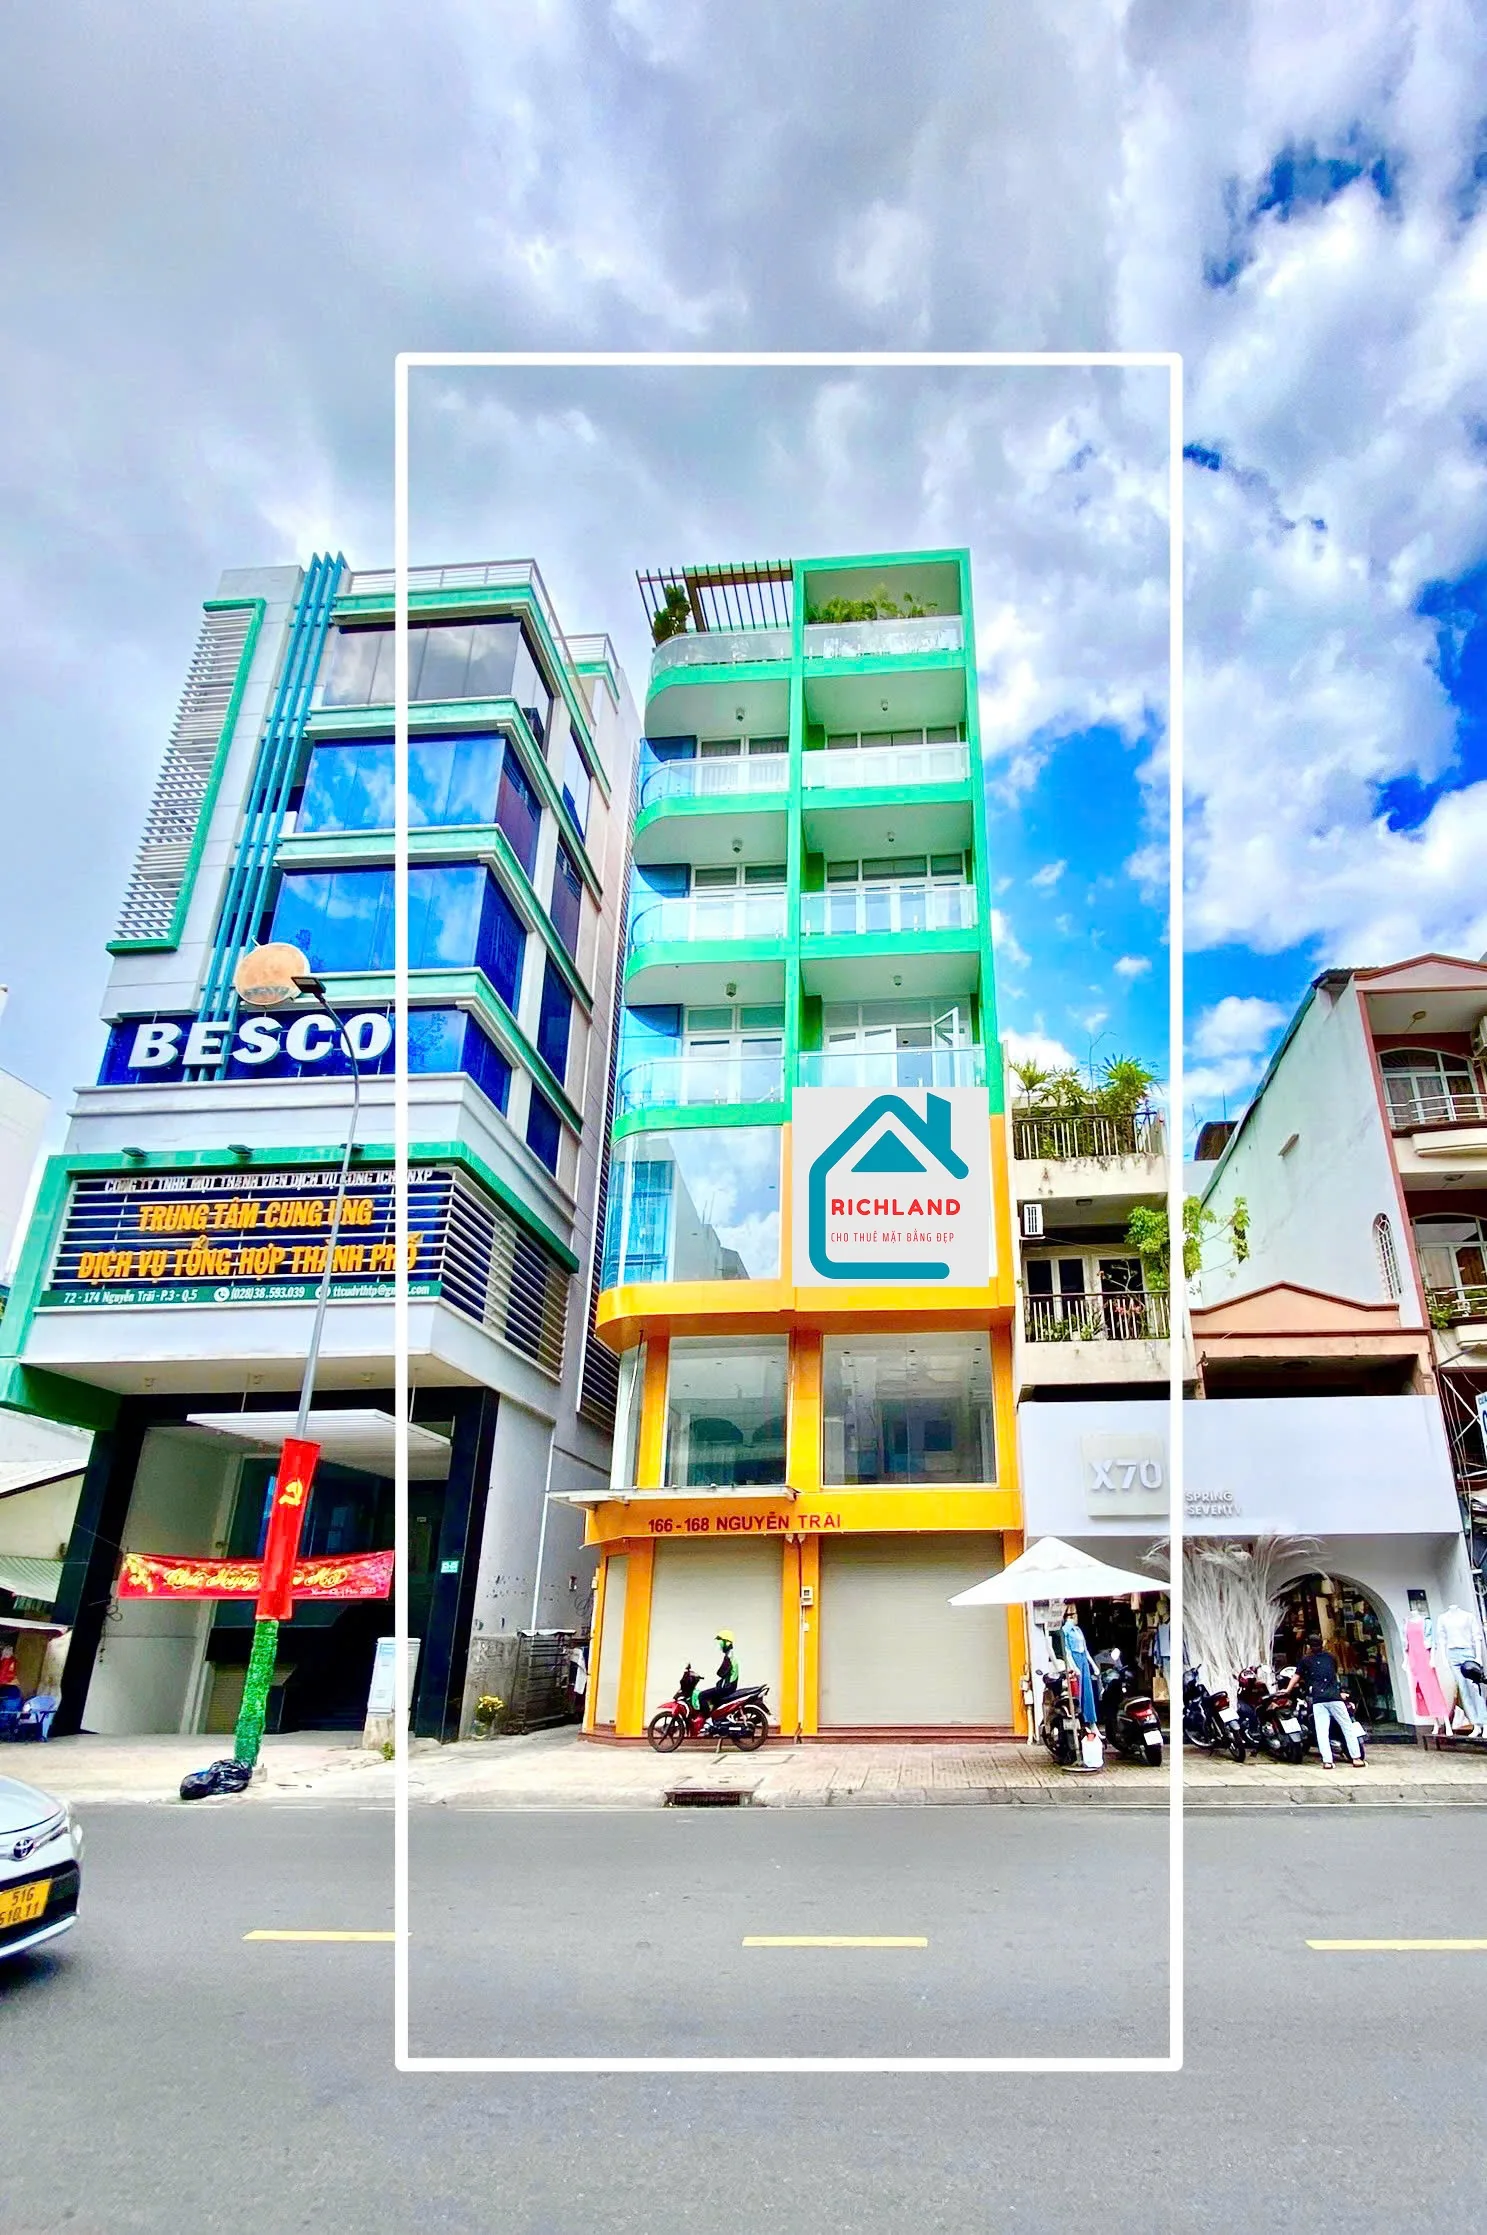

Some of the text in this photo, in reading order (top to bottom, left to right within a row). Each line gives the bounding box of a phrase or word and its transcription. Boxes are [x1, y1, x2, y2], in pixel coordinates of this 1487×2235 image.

[128, 1012, 392, 1068] BESCO
[138, 1203, 210, 1232] TRUNG
[213, 1197, 260, 1229] TÂM
[264, 1200, 324, 1228] CUNG
[77, 1251, 133, 1285] DỊCH
[138, 1250, 169, 1283] VỤ
[174, 1234, 233, 1278] TỔNG
[237, 1243, 286, 1281] HỢP
[83, 1291, 101, 1304] 174
[1089, 1458, 1164, 1492] X70
[1185, 1491, 1234, 1504] SPRING
[648, 1518, 673, 1533] 166
[684, 1517, 710, 1532] 168
